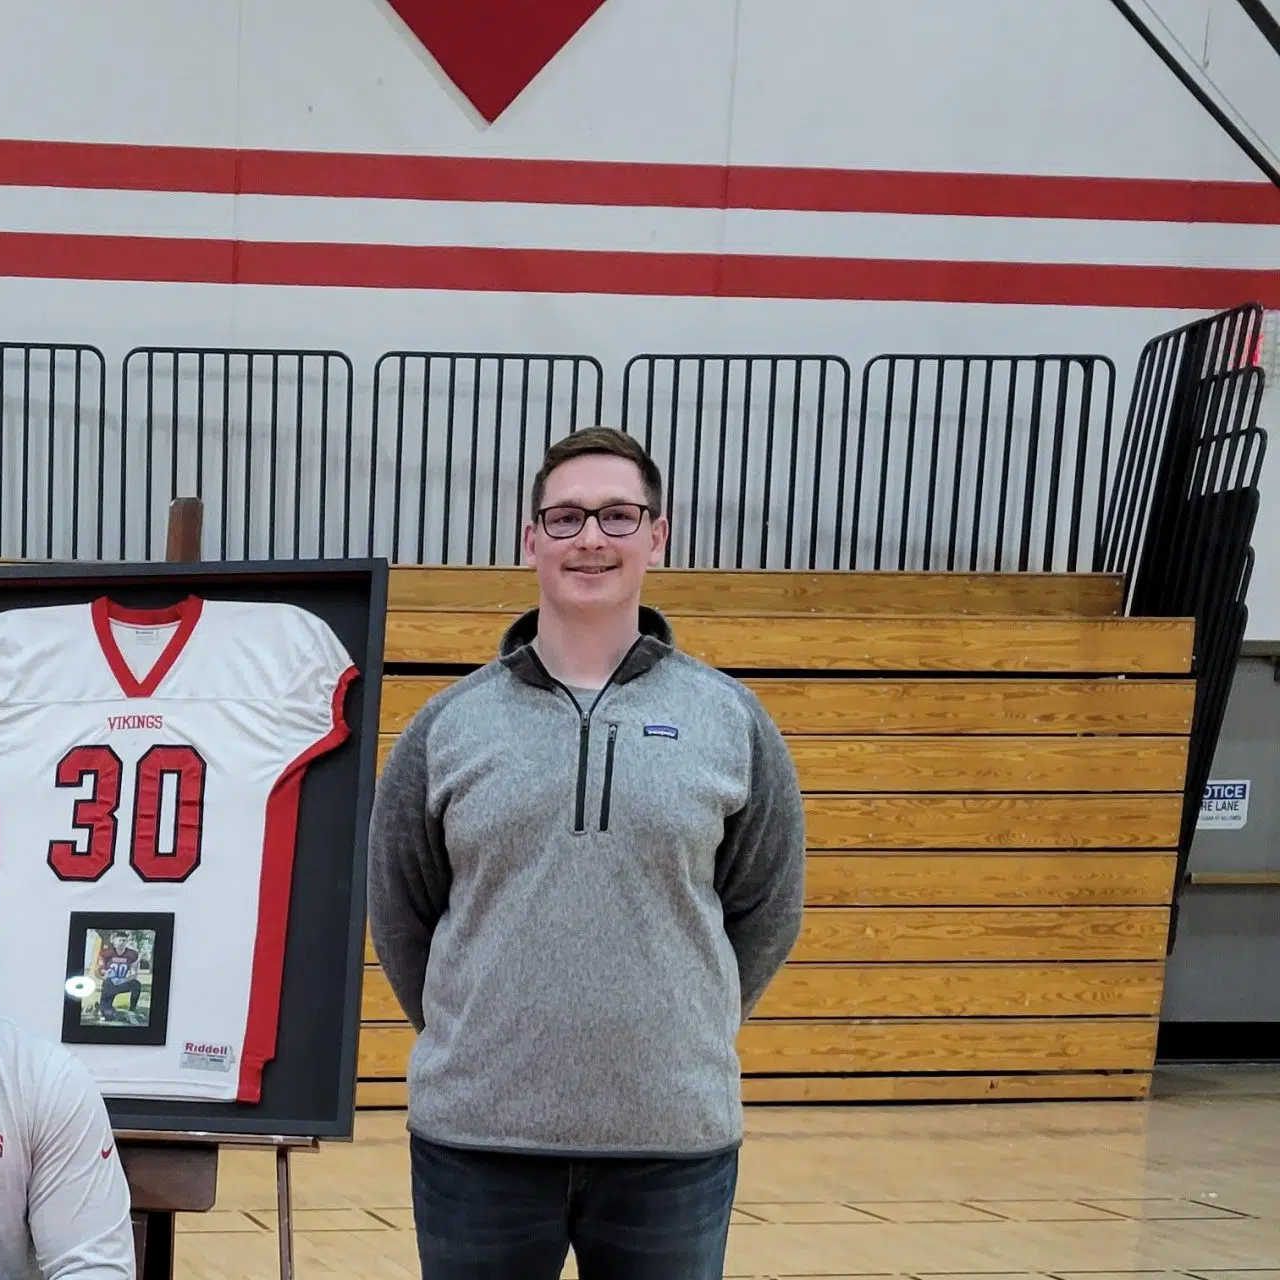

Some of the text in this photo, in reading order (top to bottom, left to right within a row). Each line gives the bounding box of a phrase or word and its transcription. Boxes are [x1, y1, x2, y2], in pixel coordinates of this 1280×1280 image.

[107, 714, 164, 731] VIKINGS
[1203, 785, 1244, 799] OTICE
[1202, 800, 1239, 811] RE LANE
[46, 744, 208, 883] 30
[185, 1042, 228, 1055] Riddell
